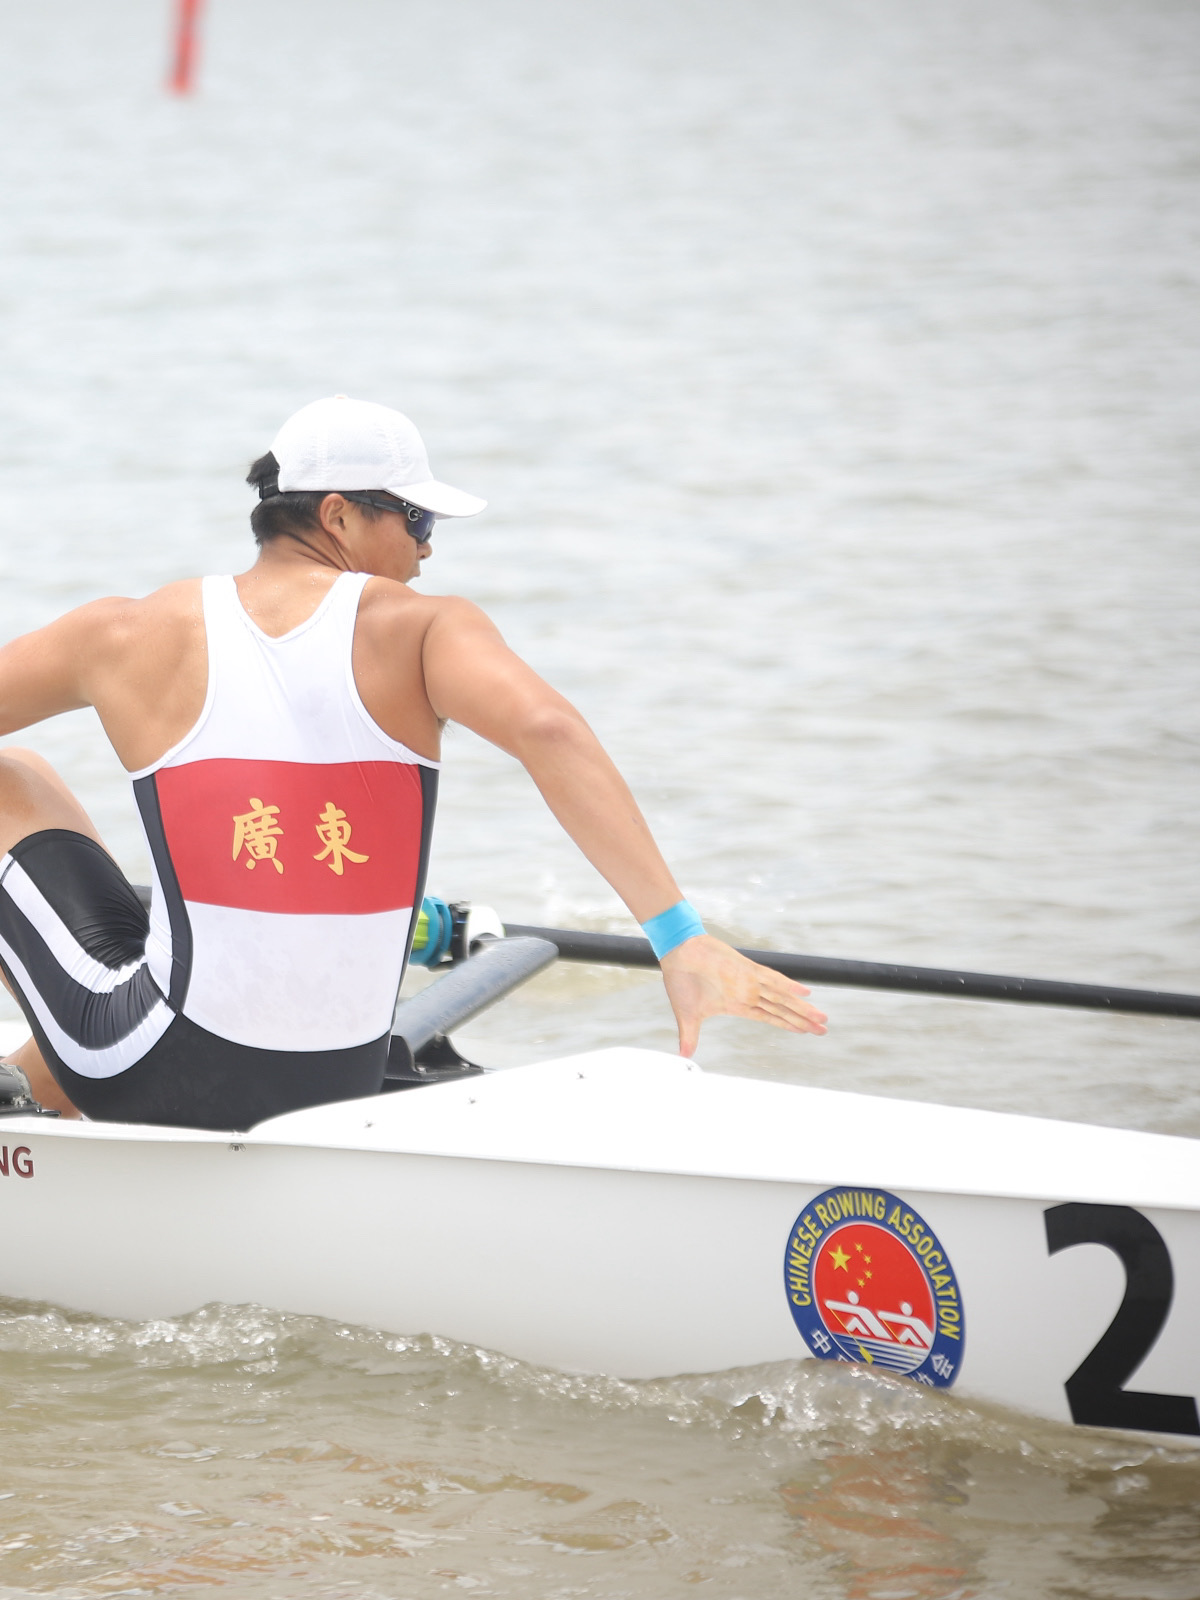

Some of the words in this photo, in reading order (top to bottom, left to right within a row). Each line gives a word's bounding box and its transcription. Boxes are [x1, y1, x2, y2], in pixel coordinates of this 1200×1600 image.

[232, 797, 370, 876] 廣東
[792, 1214, 824, 1306] CHINESE
[814, 1191, 887, 1229] ROWING
[887, 1205, 961, 1341] ASSOCIATION
[1043, 1202, 1200, 1436] 2
